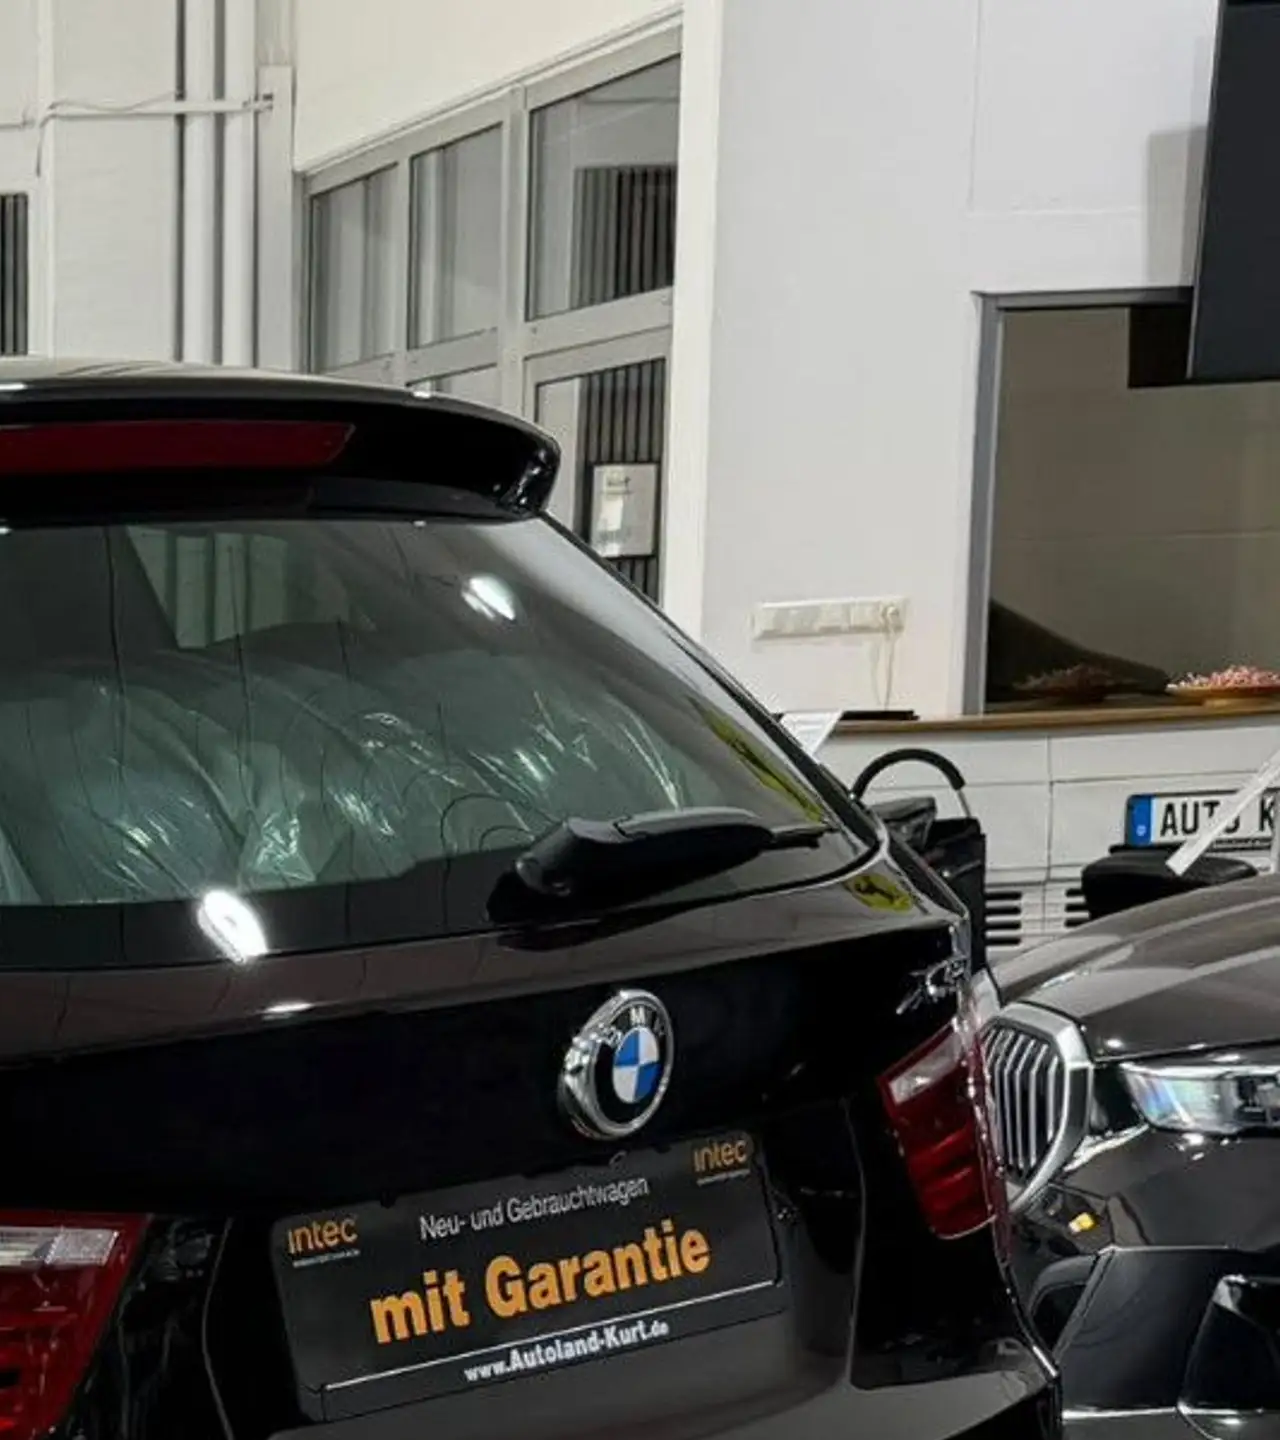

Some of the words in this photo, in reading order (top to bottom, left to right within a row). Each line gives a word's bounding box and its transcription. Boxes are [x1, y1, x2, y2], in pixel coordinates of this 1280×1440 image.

[419, 1214, 466, 1242] Neu-
[471, 1200, 504, 1232] und
[506, 1176, 651, 1224] Gebrauchtwagen
[370, 1269, 471, 1345] mit
[484, 1218, 711, 1320] Garantie
[463, 1319, 671, 1382] www.Autoland-Kurt.de
